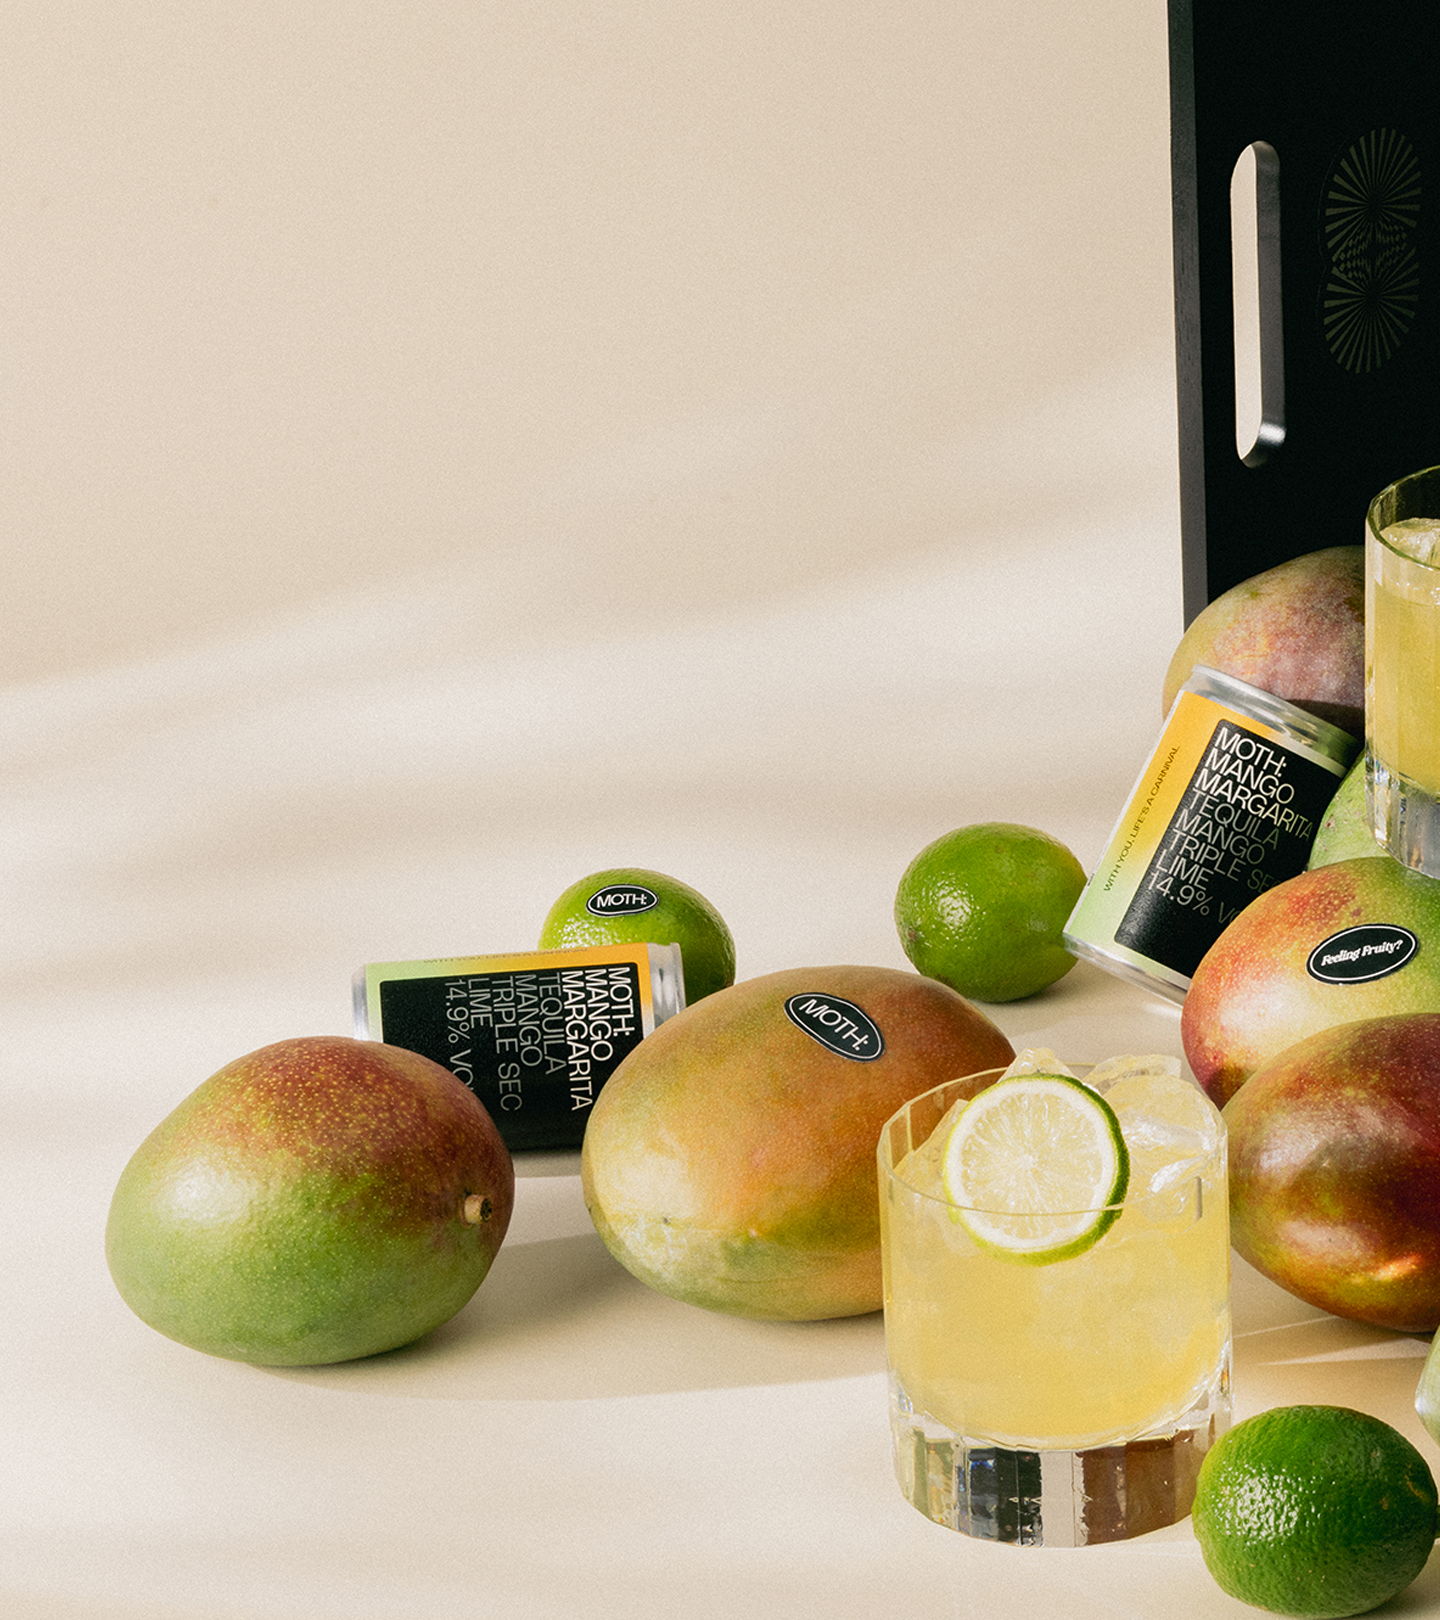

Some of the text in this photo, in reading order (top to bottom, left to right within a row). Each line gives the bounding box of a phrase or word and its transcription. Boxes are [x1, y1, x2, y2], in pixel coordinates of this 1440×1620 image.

[1204, 747, 1295, 804] MANGO
[1215, 727, 1287, 777] MOTH:
[1191, 790, 1280, 850] TEQUILA
[1194, 769, 1312, 841] MARGARITA
[1171, 829, 1281, 893] TRIPLE SE
[1175, 809, 1265, 865] MANGO
[1147, 872, 1210, 916] 14.9%
[1156, 849, 1215, 891] LIME
[597, 893, 647, 909] MOTH:
[1321, 939, 1404, 966] Feeling Fruity?
[468, 977, 493, 1028] LIME
[515, 974, 543, 1067] MANGO
[539, 972, 567, 1075] TEQUILA
[585, 969, 613, 1061] MANGO
[608, 966, 636, 1037] MOTH:
[799, 998, 869, 1051] MOTH:
[445, 978, 475, 1091] 14.9% VO
[492, 975, 523, 1111] TRIPLE SEC
[562, 971, 593, 1111] MARGARITA
